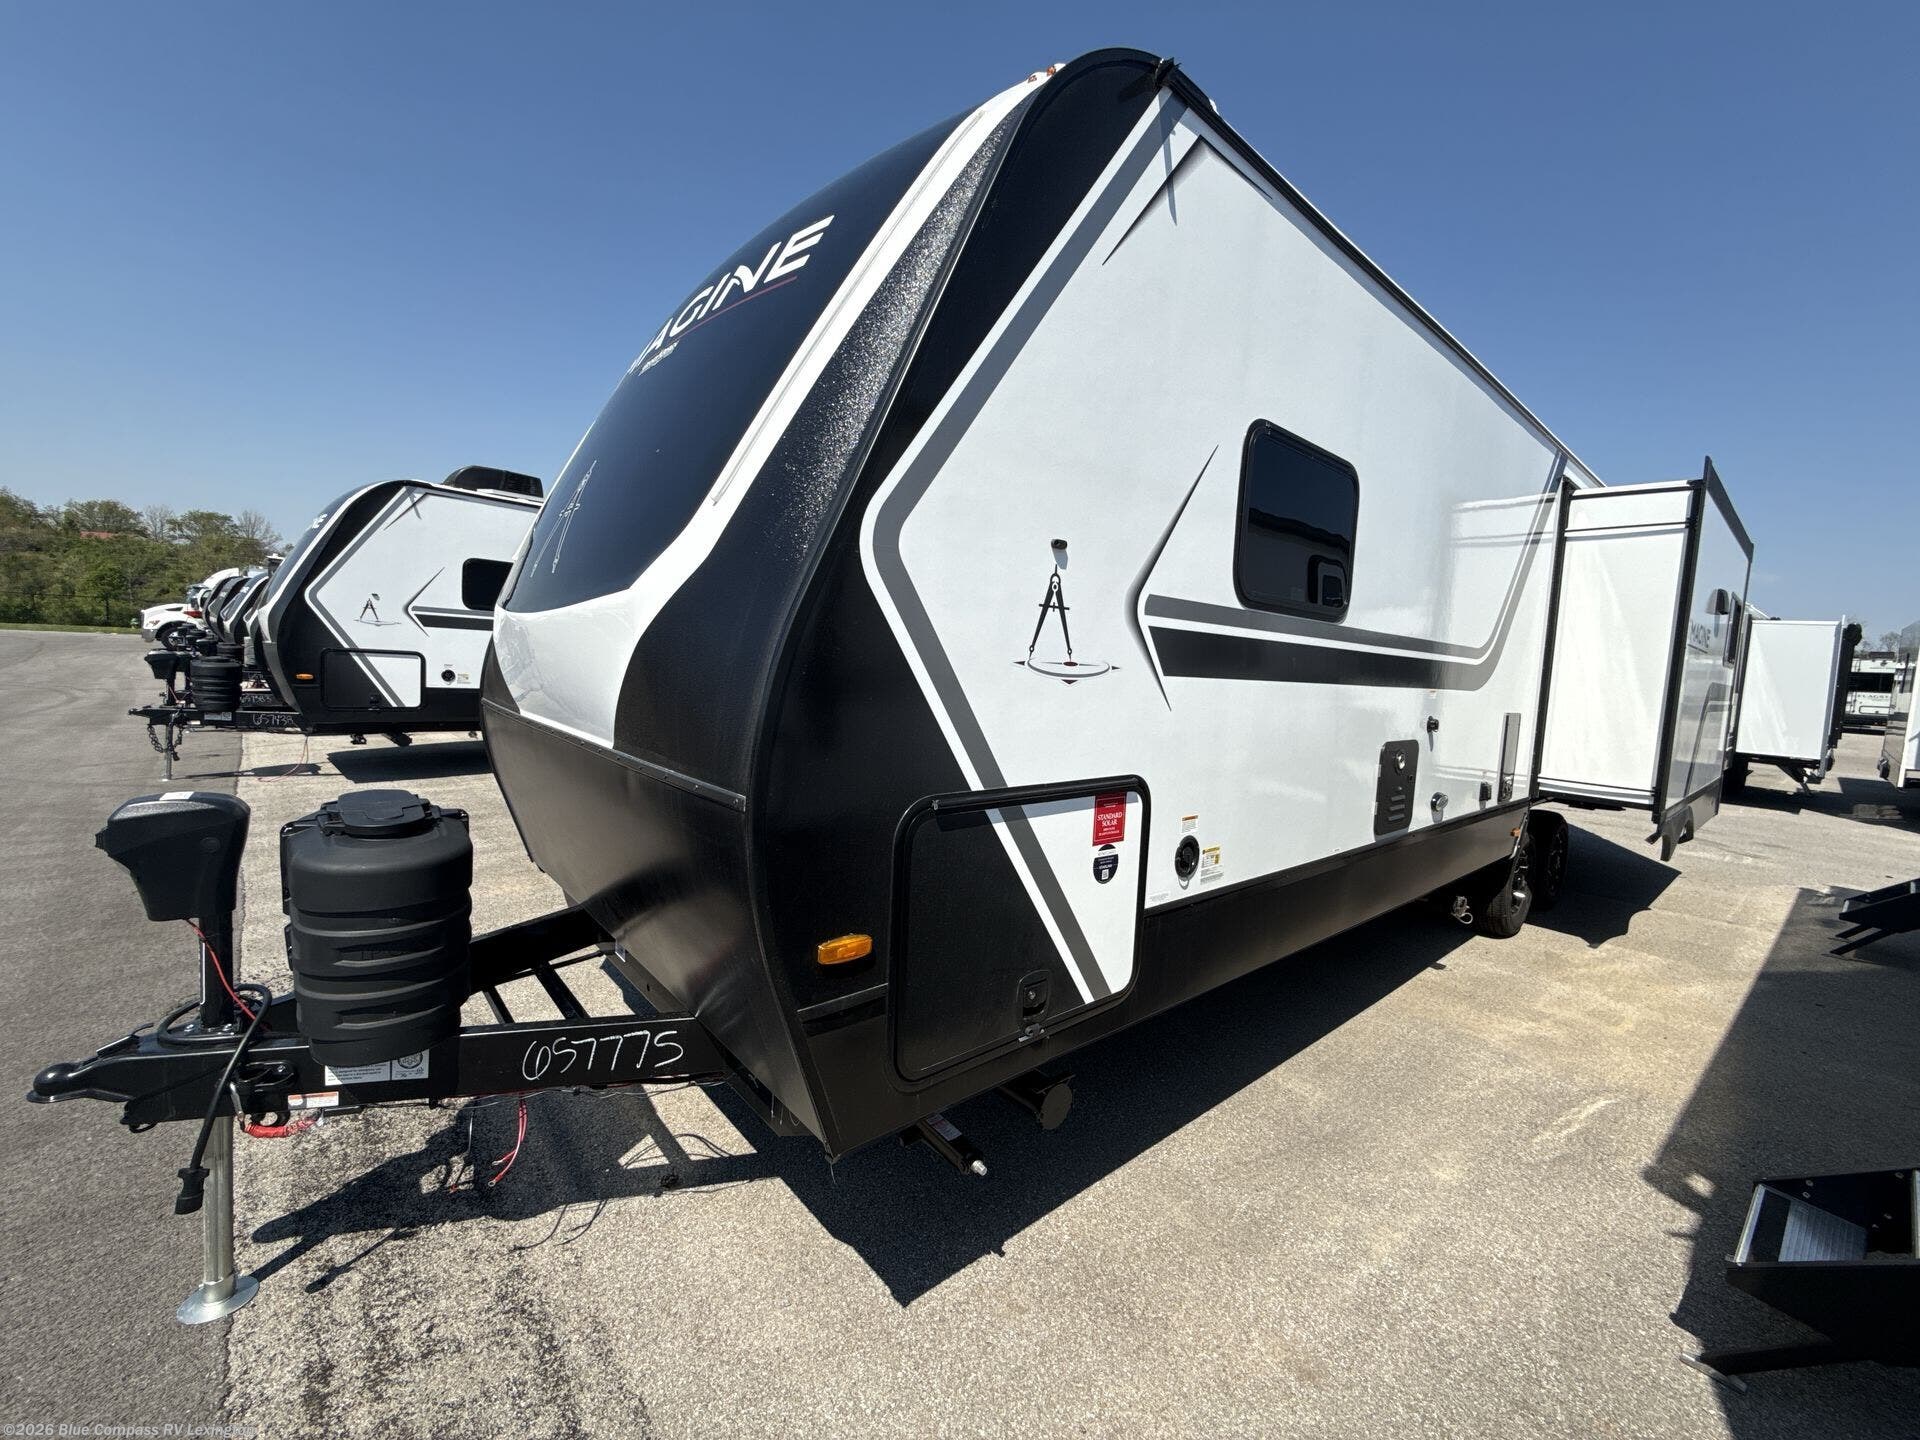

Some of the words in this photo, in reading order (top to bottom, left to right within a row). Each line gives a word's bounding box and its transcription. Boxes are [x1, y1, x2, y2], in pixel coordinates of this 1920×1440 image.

[1097, 812, 1122, 821] STANDARD
[1101, 819, 1118, 827] SOLAR
[521, 1029, 684, 1081] 657775
